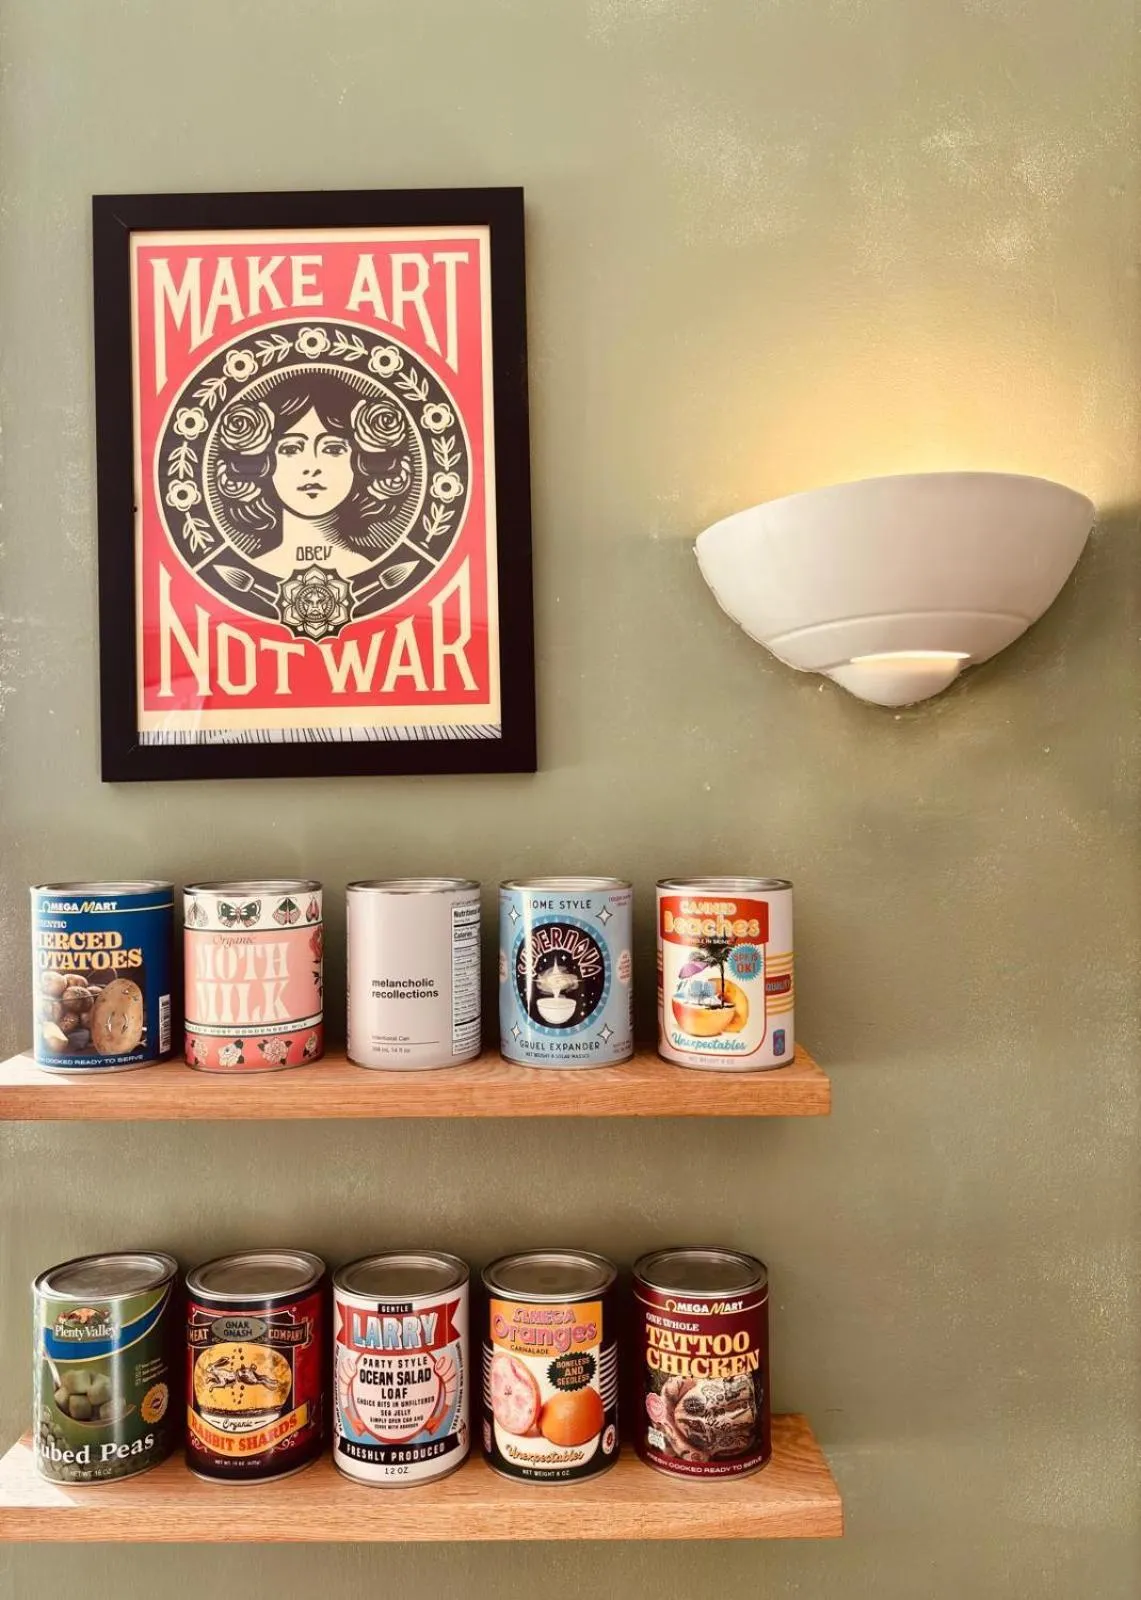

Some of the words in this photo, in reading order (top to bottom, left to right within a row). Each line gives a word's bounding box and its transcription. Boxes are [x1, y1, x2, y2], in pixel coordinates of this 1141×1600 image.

[149, 255, 324, 397] MAKE
[345, 251, 470, 375] ART
[296, 545, 334, 561] OBEY
[157, 561, 306, 698] NOT
[317, 554, 480, 695] WAR
[559, 899, 593, 910] STYLE
[40, 931, 122, 950] IERCED
[38, 948, 143, 970] OTATOES
[372, 978, 435, 988] melancholic
[372, 989, 439, 999] recollections
[519, 1039, 545, 1051] GRUEL
[549, 1041, 600, 1051] EXPANDER
[381, 1305, 409, 1313] GENTLE
[646, 1312, 662, 1325] ONE
[662, 1317, 700, 1332] WHOLE
[55, 1324, 85, 1341] Plenty
[268, 1328, 304, 1341] COMPANY
[352, 1311, 439, 1351] LARRY
[493, 1313, 598, 1352] Oranges
[645, 1323, 750, 1356] TATTOO
[363, 1357, 392, 1368] PARTY
[398, 1356, 428, 1368] STYLE
[556, 1358, 590, 1368] BONELESS
[646, 1348, 760, 1379] CHICKEN
[359, 1369, 394, 1386] OCEAN
[396, 1368, 432, 1386] SALAD
[565, 1366, 584, 1376] AND
[381, 1387, 409, 1400] LOAF
[393, 1409, 411, 1417] JELLY
[222, 1418, 254, 1431] Organic
[238, 1412, 298, 1452] SHARDS
[41, 1441, 90, 1465] ubed
[100, 1433, 154, 1462] Peas
[346, 1443, 385, 1462] FRESHLY
[391, 1442, 446, 1462] PRODUCED
[397, 1466, 409, 1474] OZ
[668, 1461, 703, 1474] COOKED
[703, 1466, 731, 1474] READY
[732, 1463, 743, 1472] TO
